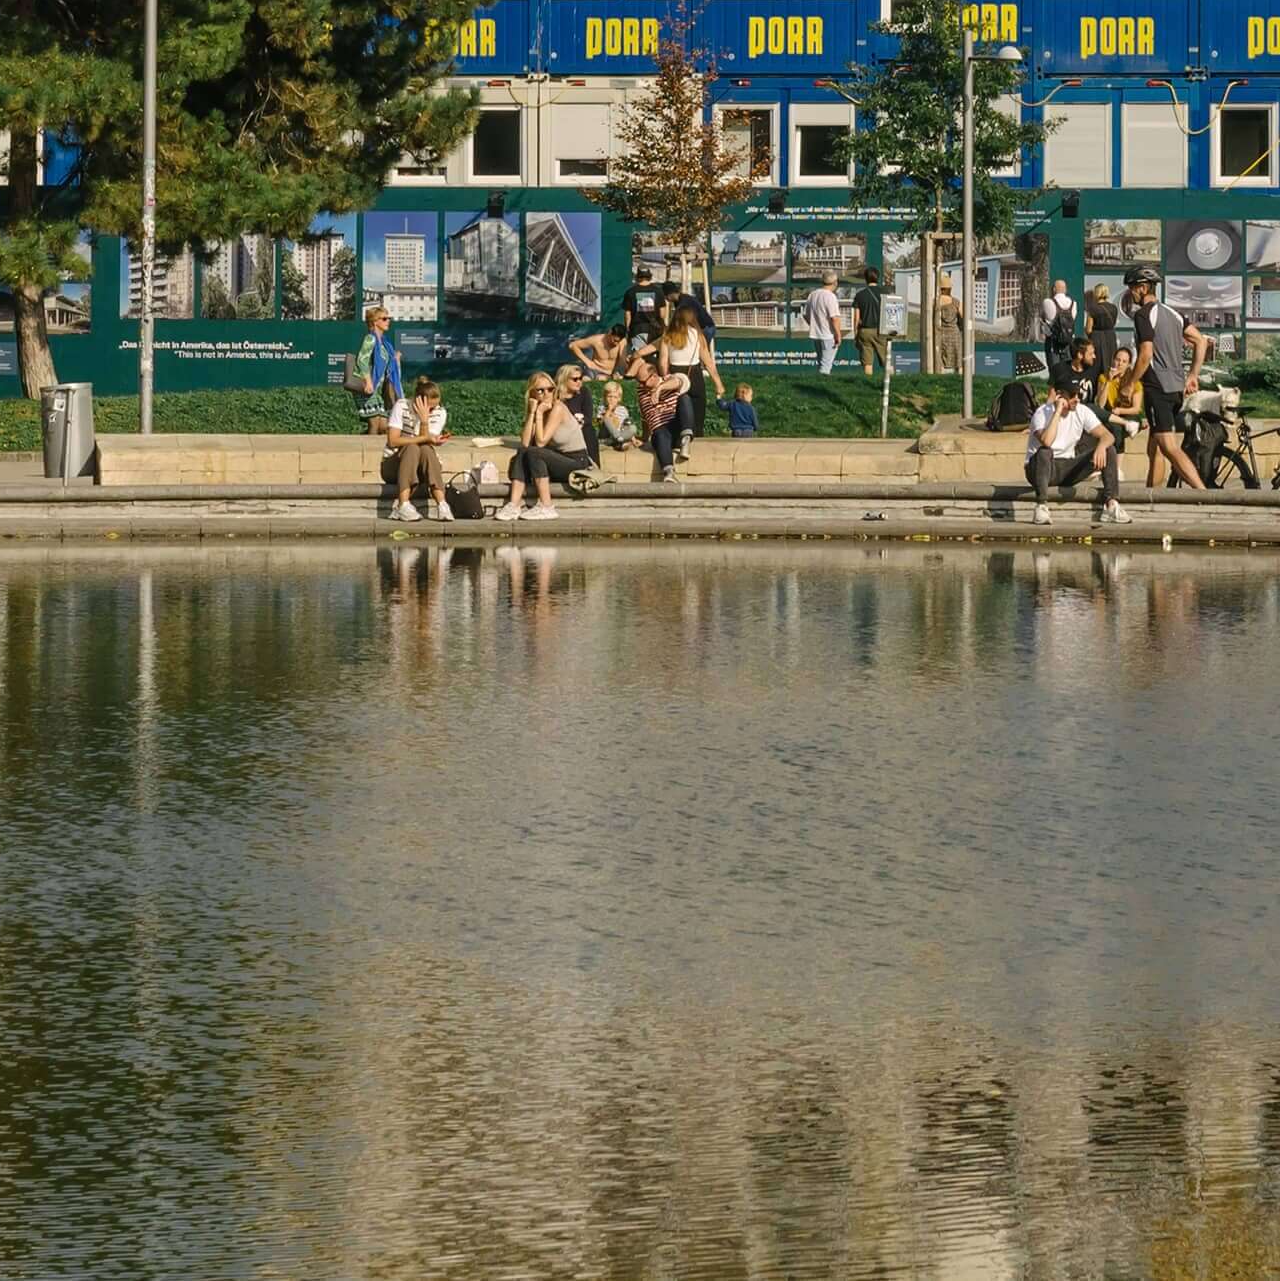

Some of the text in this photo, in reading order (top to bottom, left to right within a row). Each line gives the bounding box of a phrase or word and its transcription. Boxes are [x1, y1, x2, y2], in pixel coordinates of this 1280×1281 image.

[586, 17, 659, 59] PORR
[749, 16, 823, 59] PORR
[1080, 16, 1155, 59] PORR
[181, 341, 215, 351] Amerika,
[203, 351, 216, 359] not
[225, 351, 258, 361] America,
